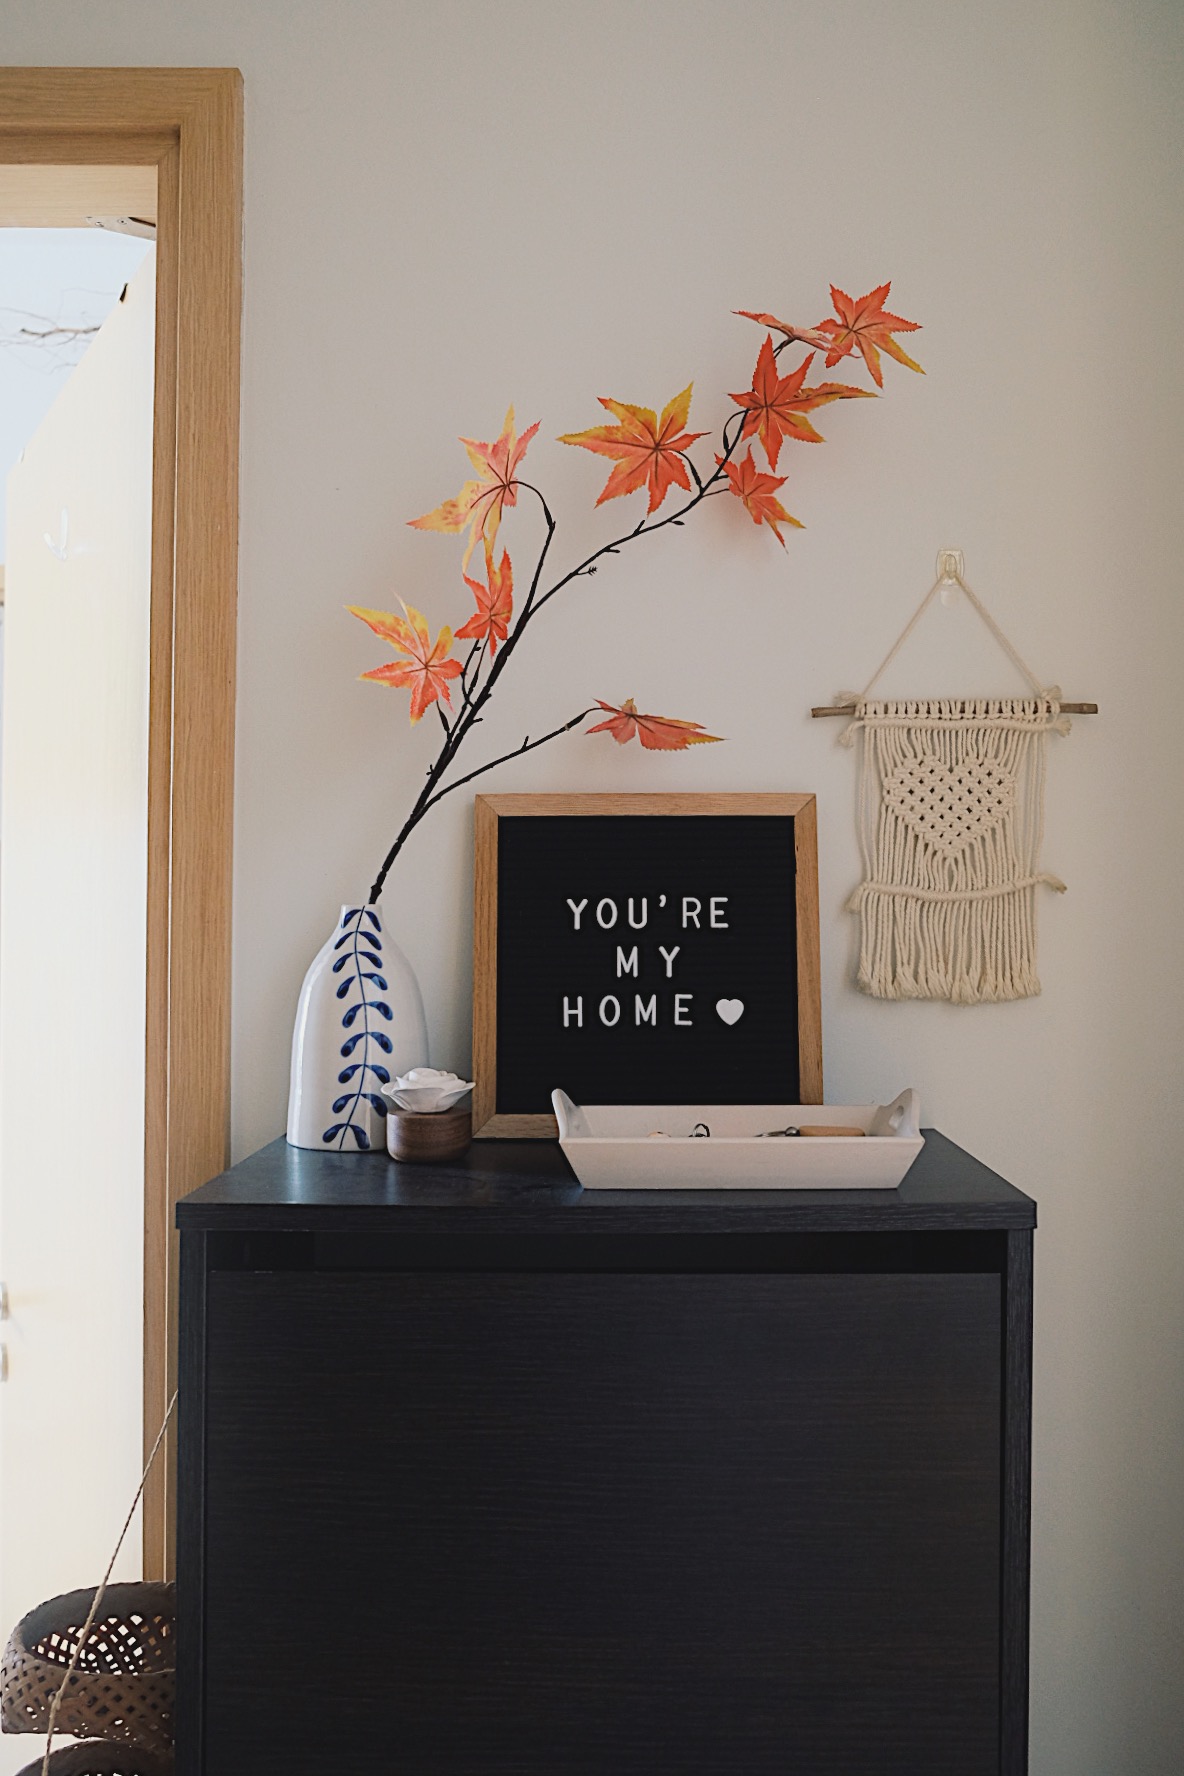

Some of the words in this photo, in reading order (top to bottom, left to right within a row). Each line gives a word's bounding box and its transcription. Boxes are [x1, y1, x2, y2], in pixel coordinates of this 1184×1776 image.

[566, 894, 729, 931] YOU'RE
[616, 945, 681, 978] MY
[562, 993, 694, 1028] HOME
